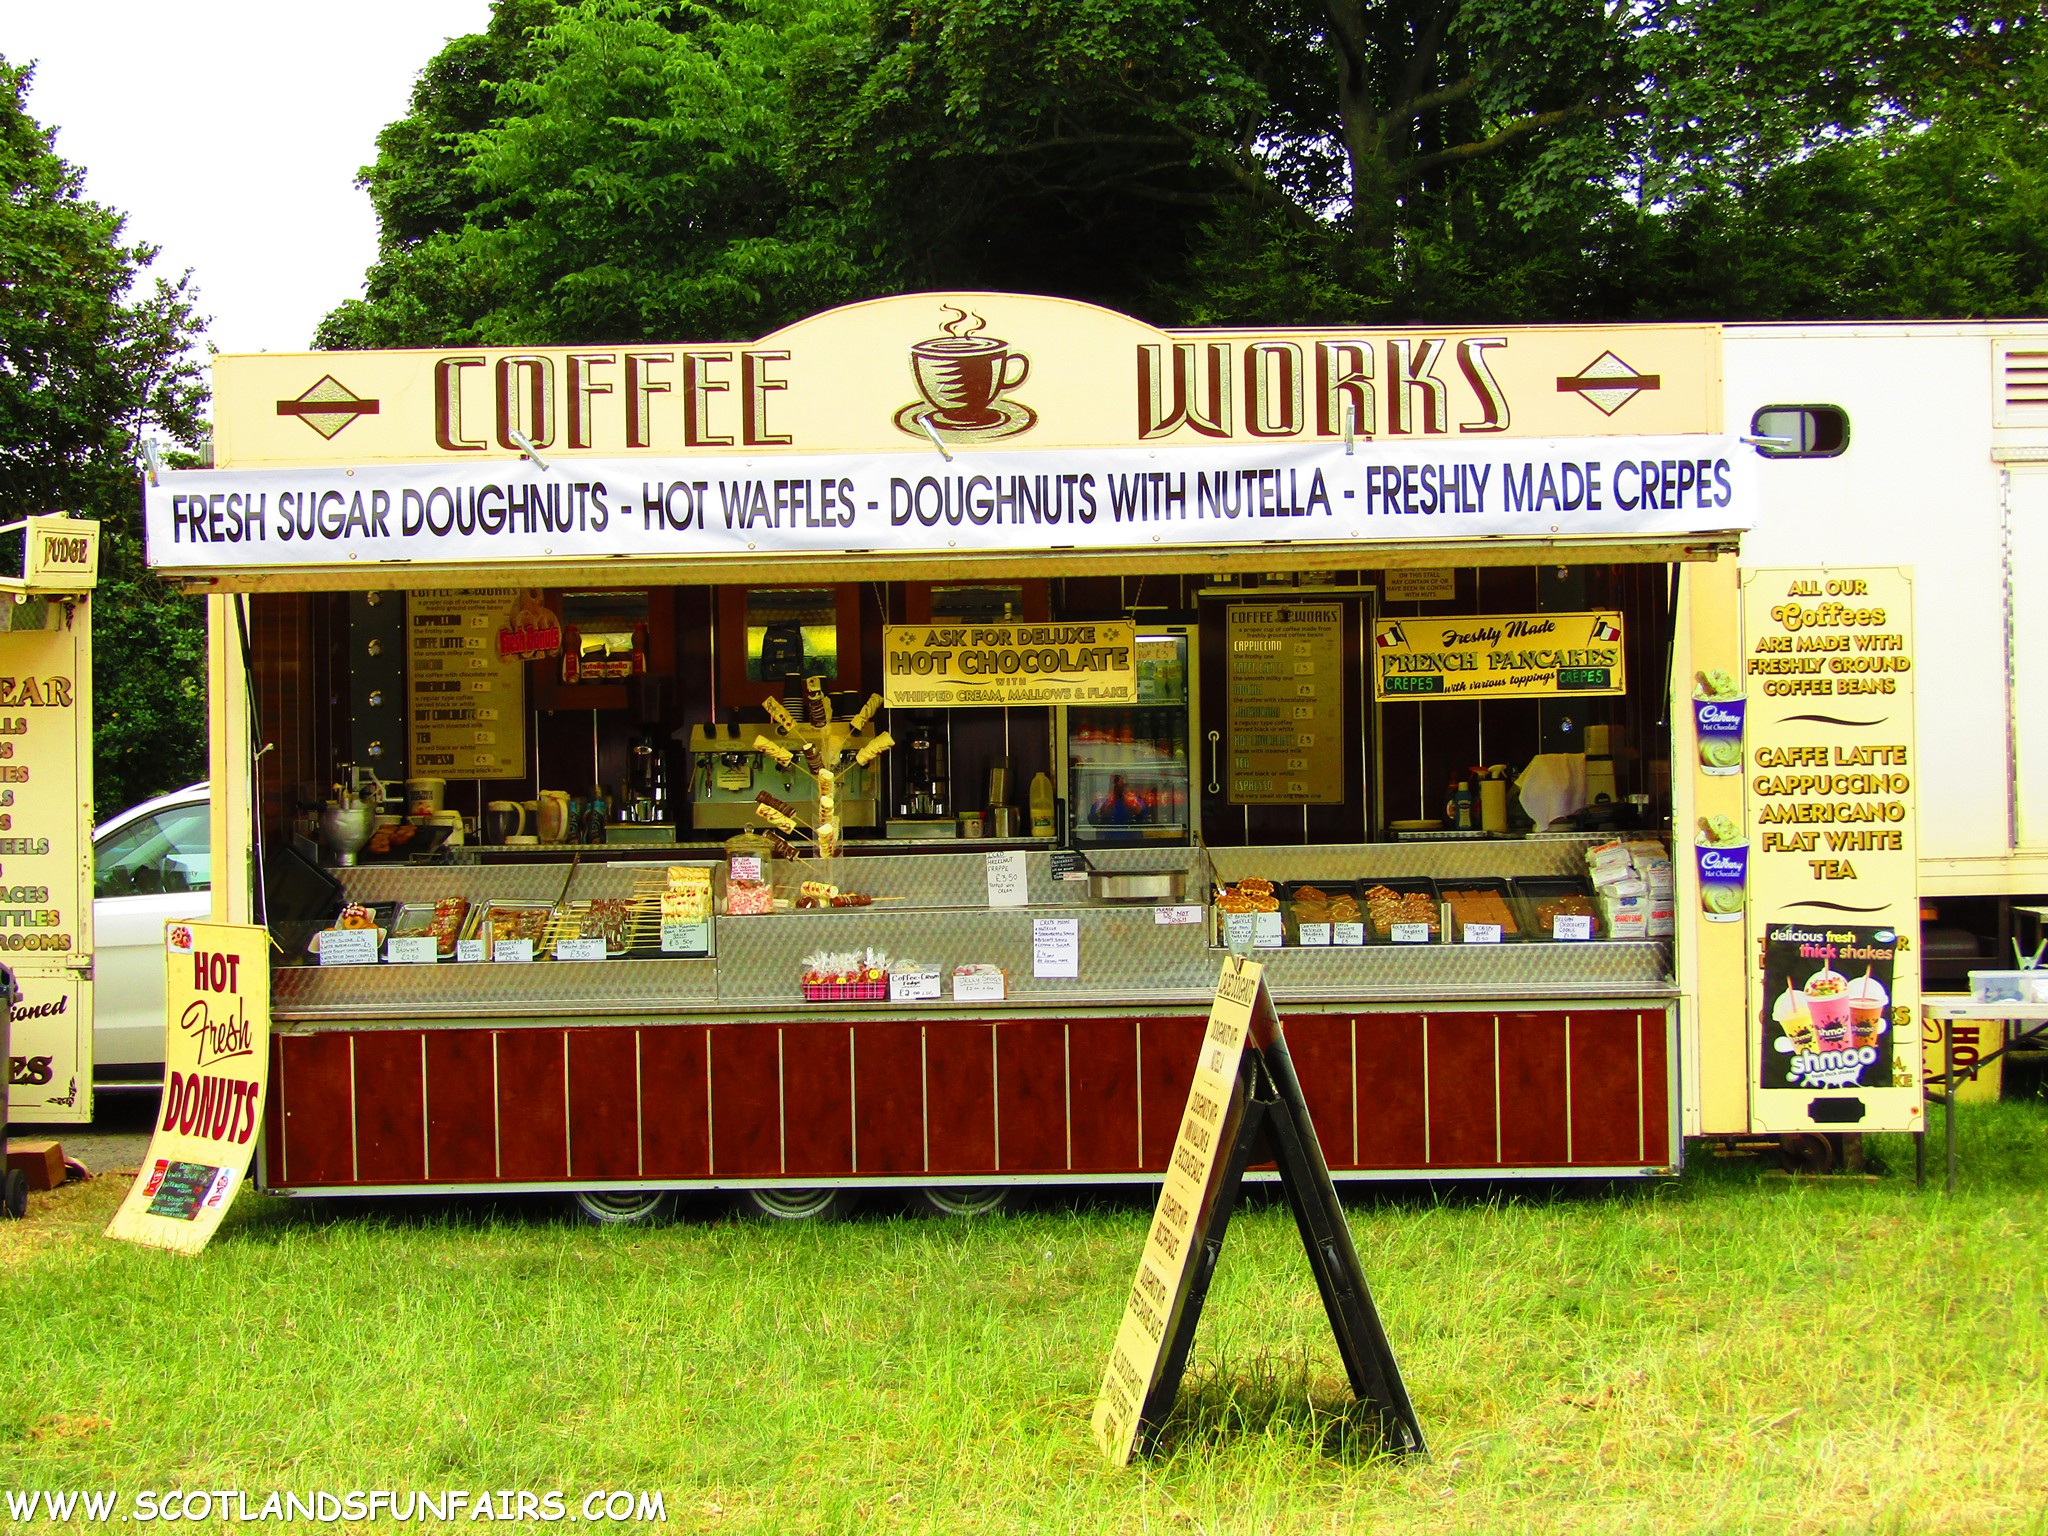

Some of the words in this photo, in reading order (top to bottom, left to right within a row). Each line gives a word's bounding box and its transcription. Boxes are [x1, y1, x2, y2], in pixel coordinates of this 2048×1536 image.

[436, 350, 793, 451] COFFEE
[1137, 337, 1511, 440] WORKS
[174, 493, 266, 543] FRESH
[277, 490, 390, 540] SUGAR
[402, 482, 609, 540] DOUGHNUTS
[645, 481, 706, 530] HOT
[721, 478, 856, 529] WAFFLES
[891, 473, 1095, 525] DOUGHNUTS
[1108, 469, 1187, 522] WITH
[1198, 467, 1332, 519] NUTELLA
[1368, 463, 1492, 515] FRESHLY
[1505, 462, 1601, 512] MADE
[1617, 458, 1732, 512] CREPES
[44, 536, 88, 567] FUDGE
[1788, 580, 1822, 596] ALL
[1826, 580, 1867, 595] OUR
[1232, 611, 1273, 623] COFFEE
[1295, 610, 1338, 622] WORKS
[1771, 602, 1886, 631] Coffees
[500, 628, 525, 656] Fresh
[525, 624, 561, 652] Donuts
[924, 629, 967, 647] ASK
[971, 628, 1012, 646] FOR
[1017, 627, 1096, 645] DELUXE
[1442, 630, 1502, 647] Freshly
[1505, 620, 1555, 638] Made
[1756, 637, 1792, 653] ARE
[1797, 636, 1850, 652] MADE
[1853, 634, 1902, 650] WITH
[1234, 641, 1282, 651] CAPPUCCINO
[890, 650, 952, 675] HOT
[958, 647, 1129, 675] CHOCOLATE
[1382, 651, 1478, 676] FRENCH
[1487, 648, 1618, 671] PANCAKES
[1747, 658, 1825, 675] FRESHLY
[1829, 656, 1910, 673] GROUND
[995, 678, 1027, 686] WITH
[1445, 680, 1467, 693] with
[1469, 679, 1506, 690] various
[1509, 671, 1555, 689] toppings
[1763, 679, 1832, 695] COFFEE
[1837, 678, 1895, 694] BEANS
[893, 690, 953, 702] WHIPPED
[1008, 687, 1071, 700] MALLOWS
[1074, 688, 1084, 699] &
[1087, 686, 1128, 699] FLAKE
[1699, 705, 1742, 725] Cadbury
[1716, 722, 1738, 731] Chocolate
[1755, 747, 1828, 767] CAFFE
[1834, 745, 1907, 765] LATTE
[1753, 774, 1910, 796] CAPPUCCINO
[1759, 802, 1905, 824] AMERICANO
[1762, 832, 1820, 852] FLAT
[1824, 830, 1902, 851] WHITE
[1701, 851, 1743, 871] Cadbury
[1809, 860, 1856, 879] TEA
[1719, 869, 1740, 877] Chocolate
[1770, 929, 1823, 942] delicious
[1826, 931, 1856, 943] fresh
[1800, 943, 1837, 958] thick
[1839, 944, 1893, 960] shakes
[194, 952, 240, 993] HOT
[180, 996, 254, 1067] Fresh
[1819, 1026, 1847, 1036] shmoo
[1790, 1045, 1877, 1075] shmoo
[162, 1071, 259, 1144] DONUTS
